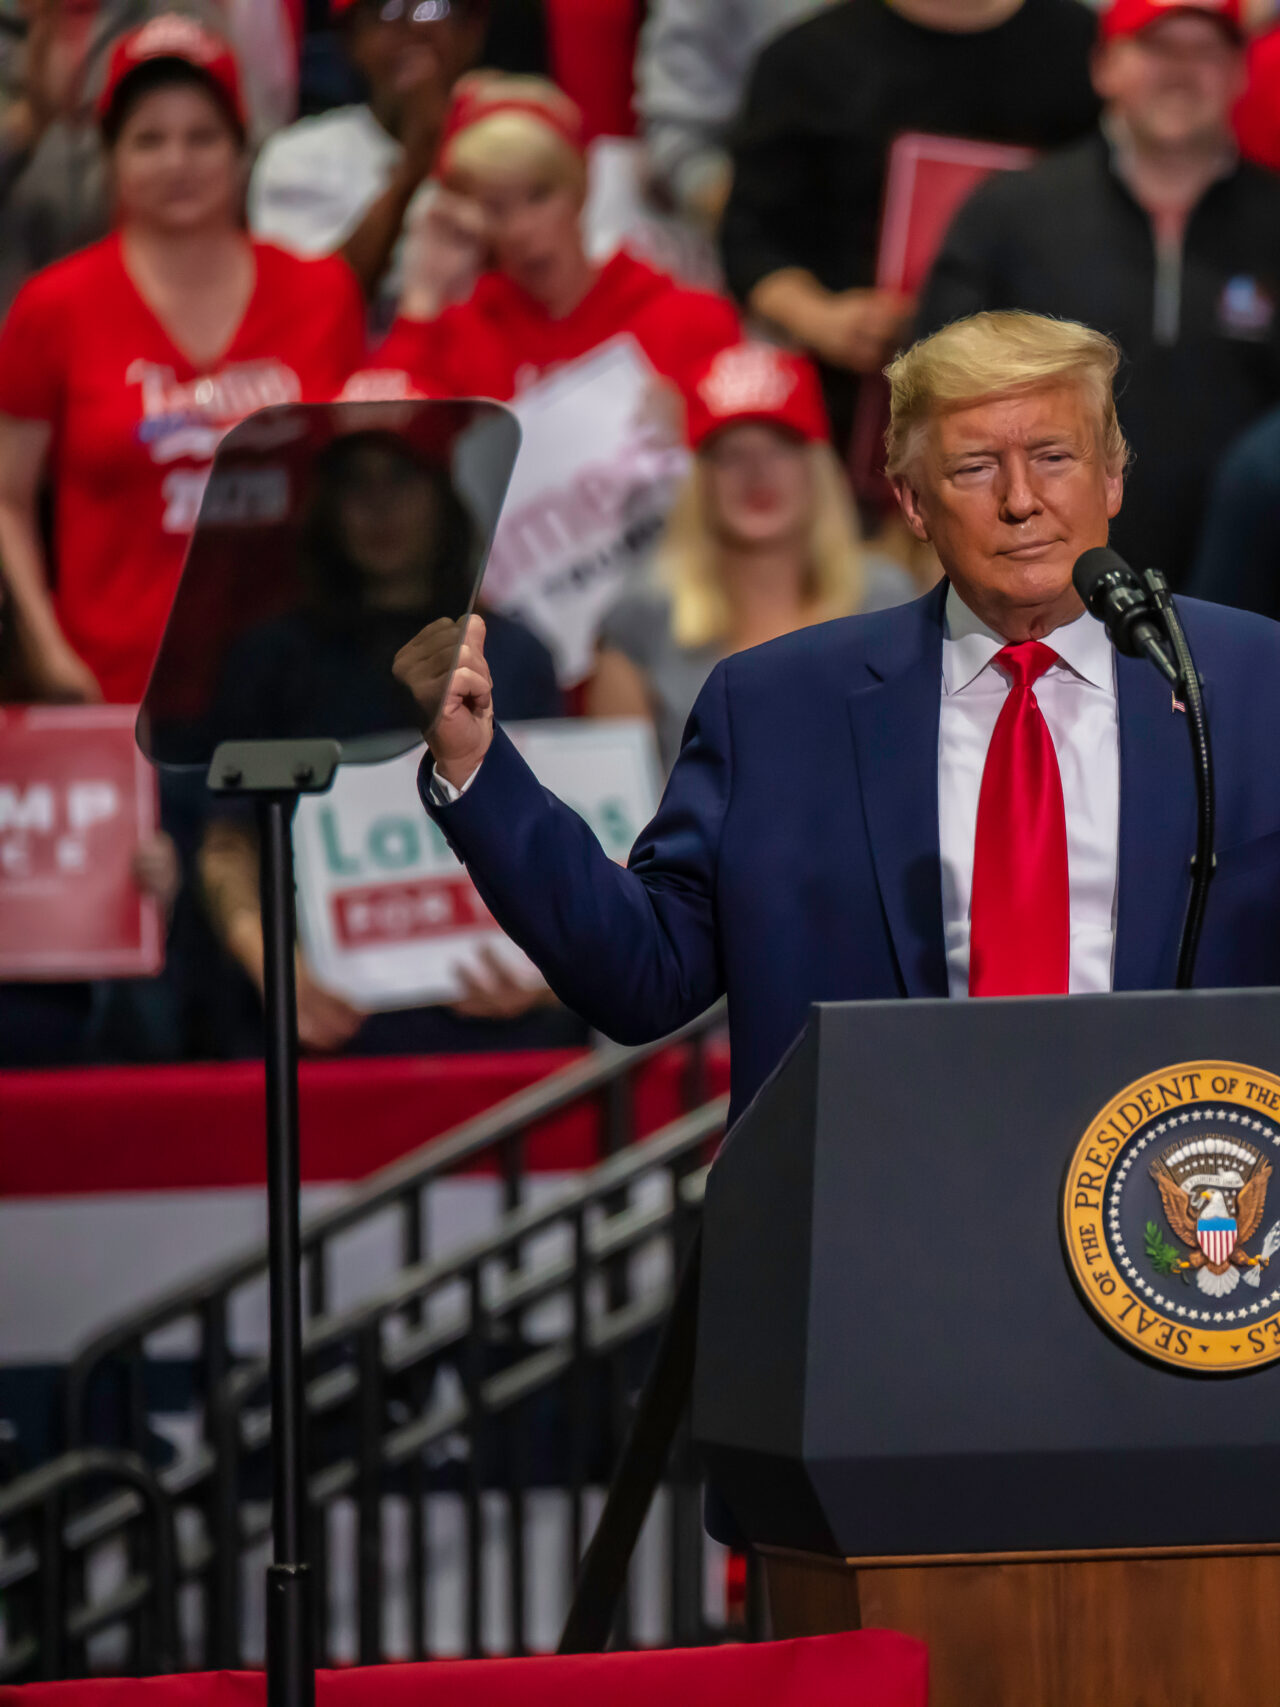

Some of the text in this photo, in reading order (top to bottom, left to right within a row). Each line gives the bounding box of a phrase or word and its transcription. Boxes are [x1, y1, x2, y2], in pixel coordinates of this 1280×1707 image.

[1211, 1076, 1239, 1095] OF
[1075, 1072, 1202, 1211] PRESIDENT
[1079, 1223, 1103, 1266] THE
[1092, 1270, 1116, 1297] OF
[1114, 1293, 1193, 1356] SEAL
